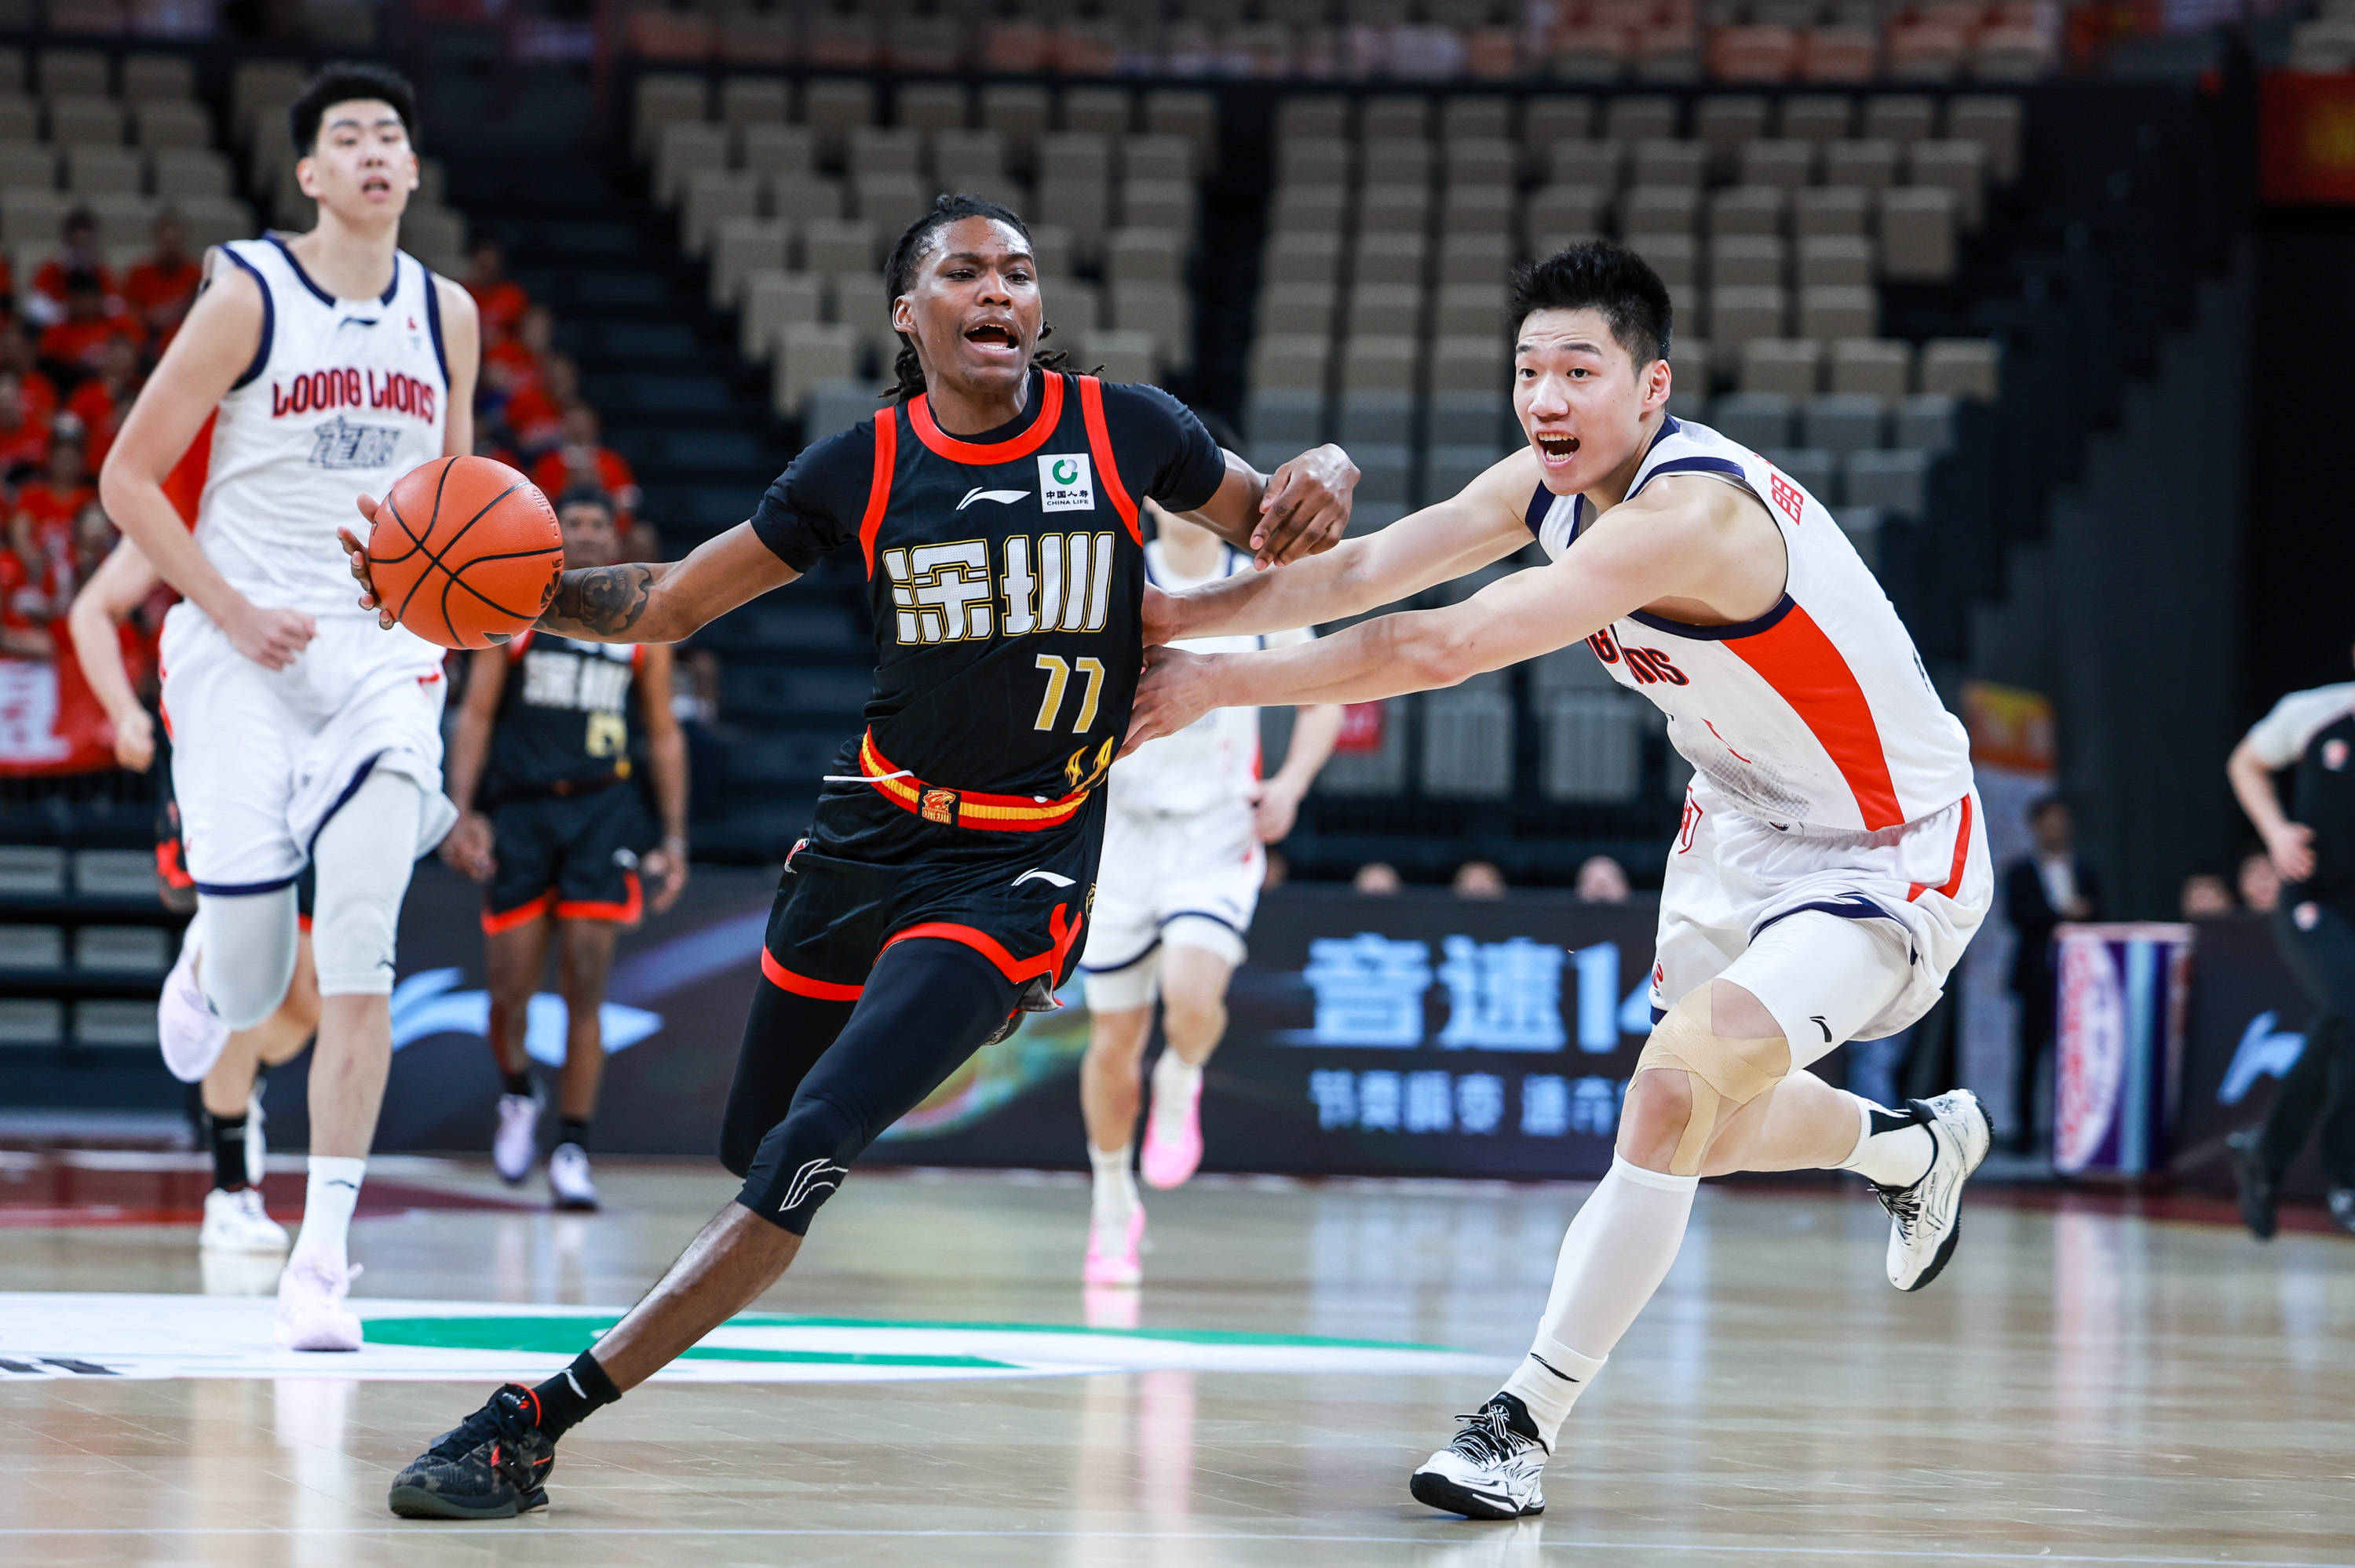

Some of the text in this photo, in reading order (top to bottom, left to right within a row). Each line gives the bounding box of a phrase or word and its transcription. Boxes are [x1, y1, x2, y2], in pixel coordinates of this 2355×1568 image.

[272, 367, 434, 425] LOONG LIONS
[1046, 490, 1089, 500] 中国人寿
[882, 531, 1115, 645] 深圳
[1034, 653, 1105, 734] 77
